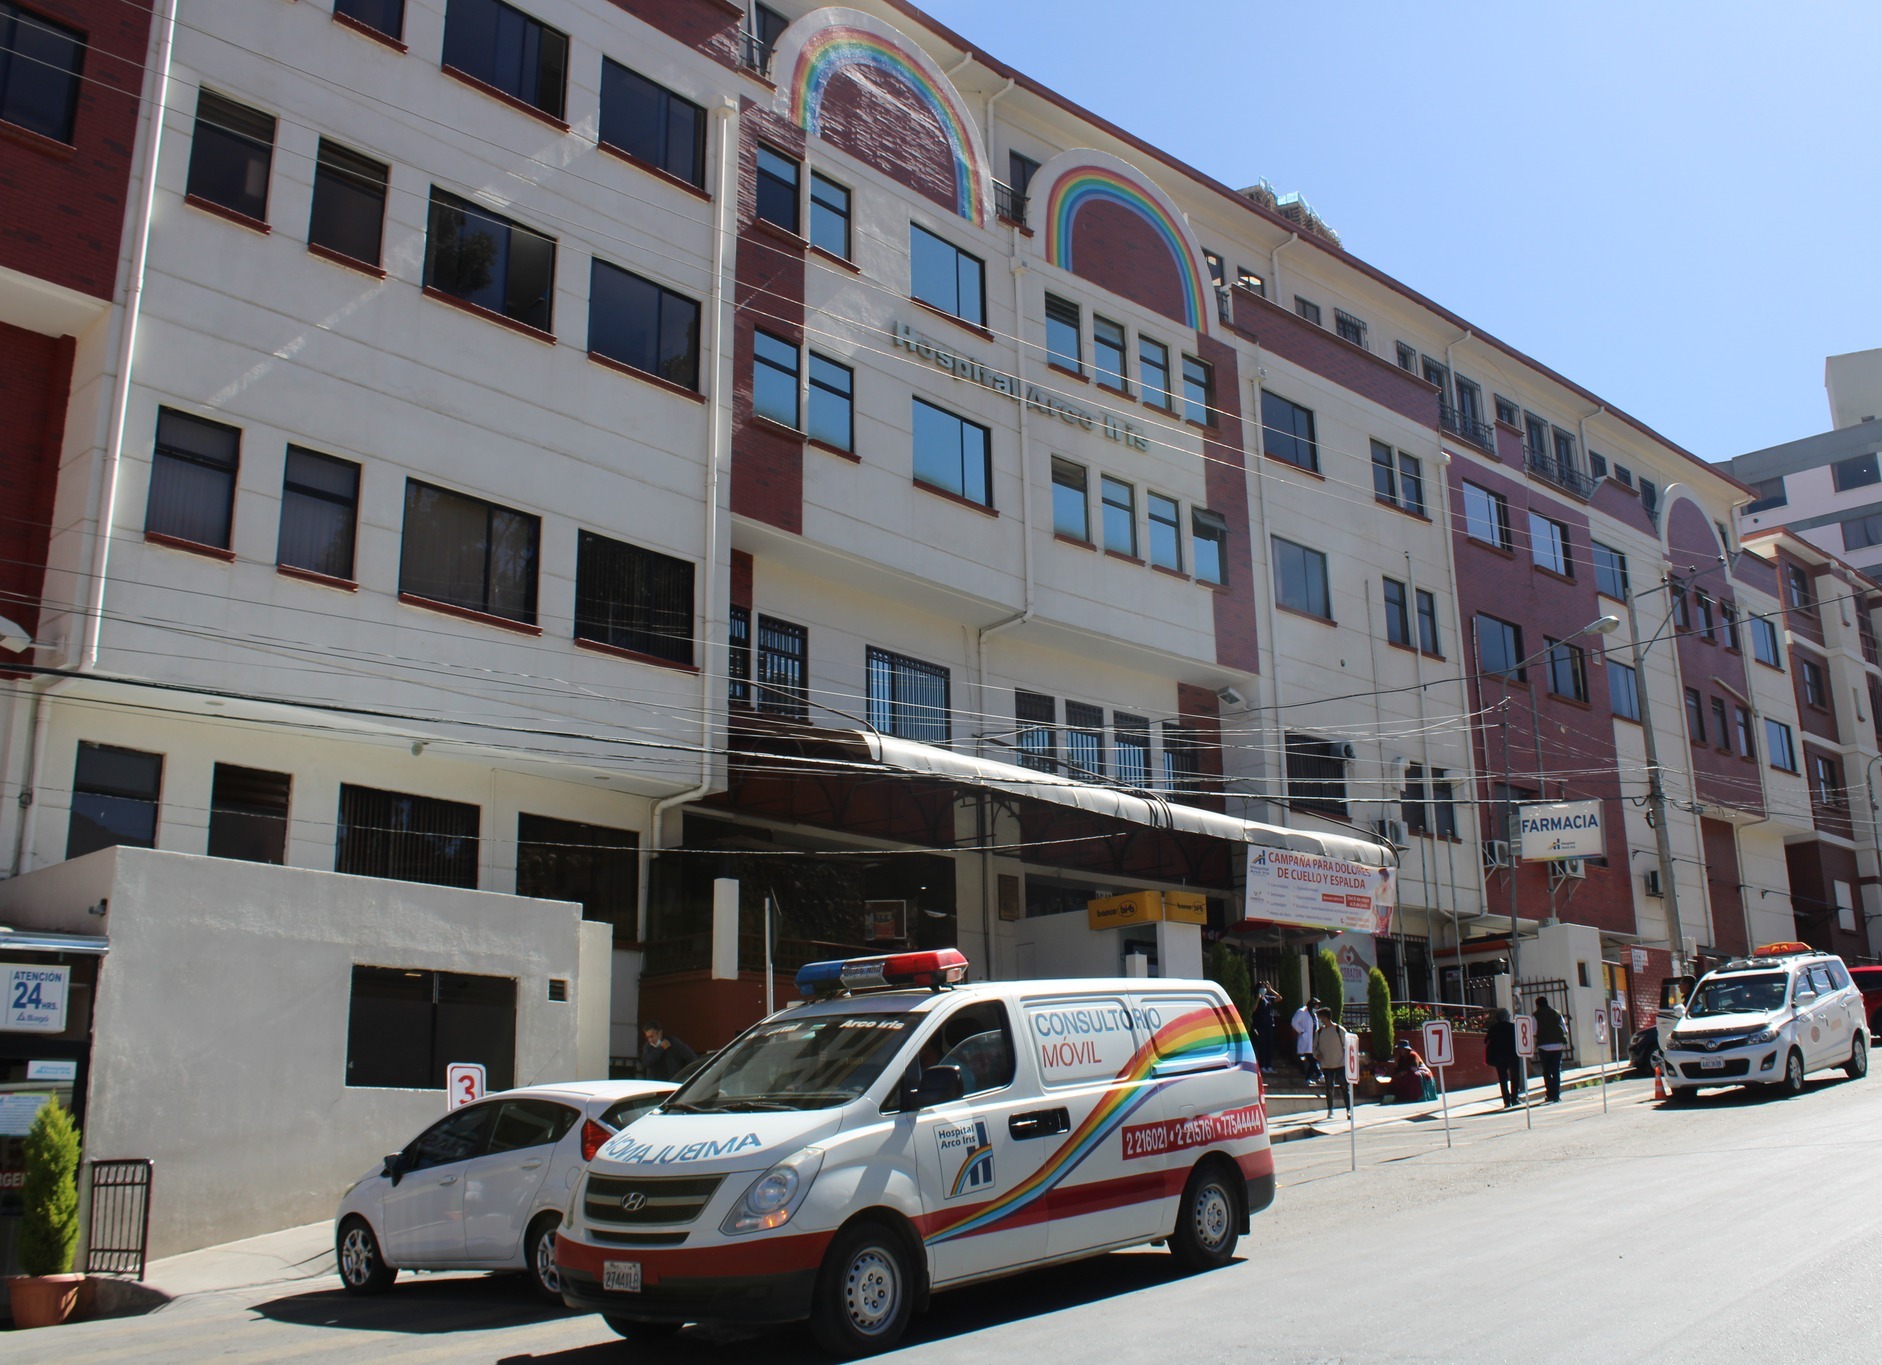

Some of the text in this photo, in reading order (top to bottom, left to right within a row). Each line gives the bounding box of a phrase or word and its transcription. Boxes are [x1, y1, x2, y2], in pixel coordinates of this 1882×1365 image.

[893, 320, 1150, 452] Hospital Arco Iris
[1521, 814, 1599, 833] FARMACIA
[1268, 852, 1371, 877] CAMPAÑA PARA DOLORES
[1277, 867, 1289, 879] DE
[1291, 869, 1322, 884] CUELLO
[1323, 874, 1330, 885] Y
[1330, 875, 1366, 889] ESPALDA
[13, 971, 62, 982] ATENCIÓN
[12, 981, 42, 1010] 24
[839, 1019, 877, 1028] Arco
[877, 1020, 905, 1029] Iris
[1035, 1007, 1162, 1037] CONSULTORIO
[1521, 1022, 1528, 1047] 8
[1042, 1036, 1102, 1068] MÓVIL
[1431, 1029, 1443, 1057] 7
[1349, 1044, 1355, 1074] 6
[457, 1074, 476, 1105] 3
[938, 1124, 975, 1139] Hospital
[941, 1135, 976, 1149] Arco Iris
[1126, 1132, 1134, 1155] 2
[1135, 1127, 1168, 1153] 216021
[1175, 1123, 1184, 1145] 2
[1220, 1109, 1262, 1136] 77544444
